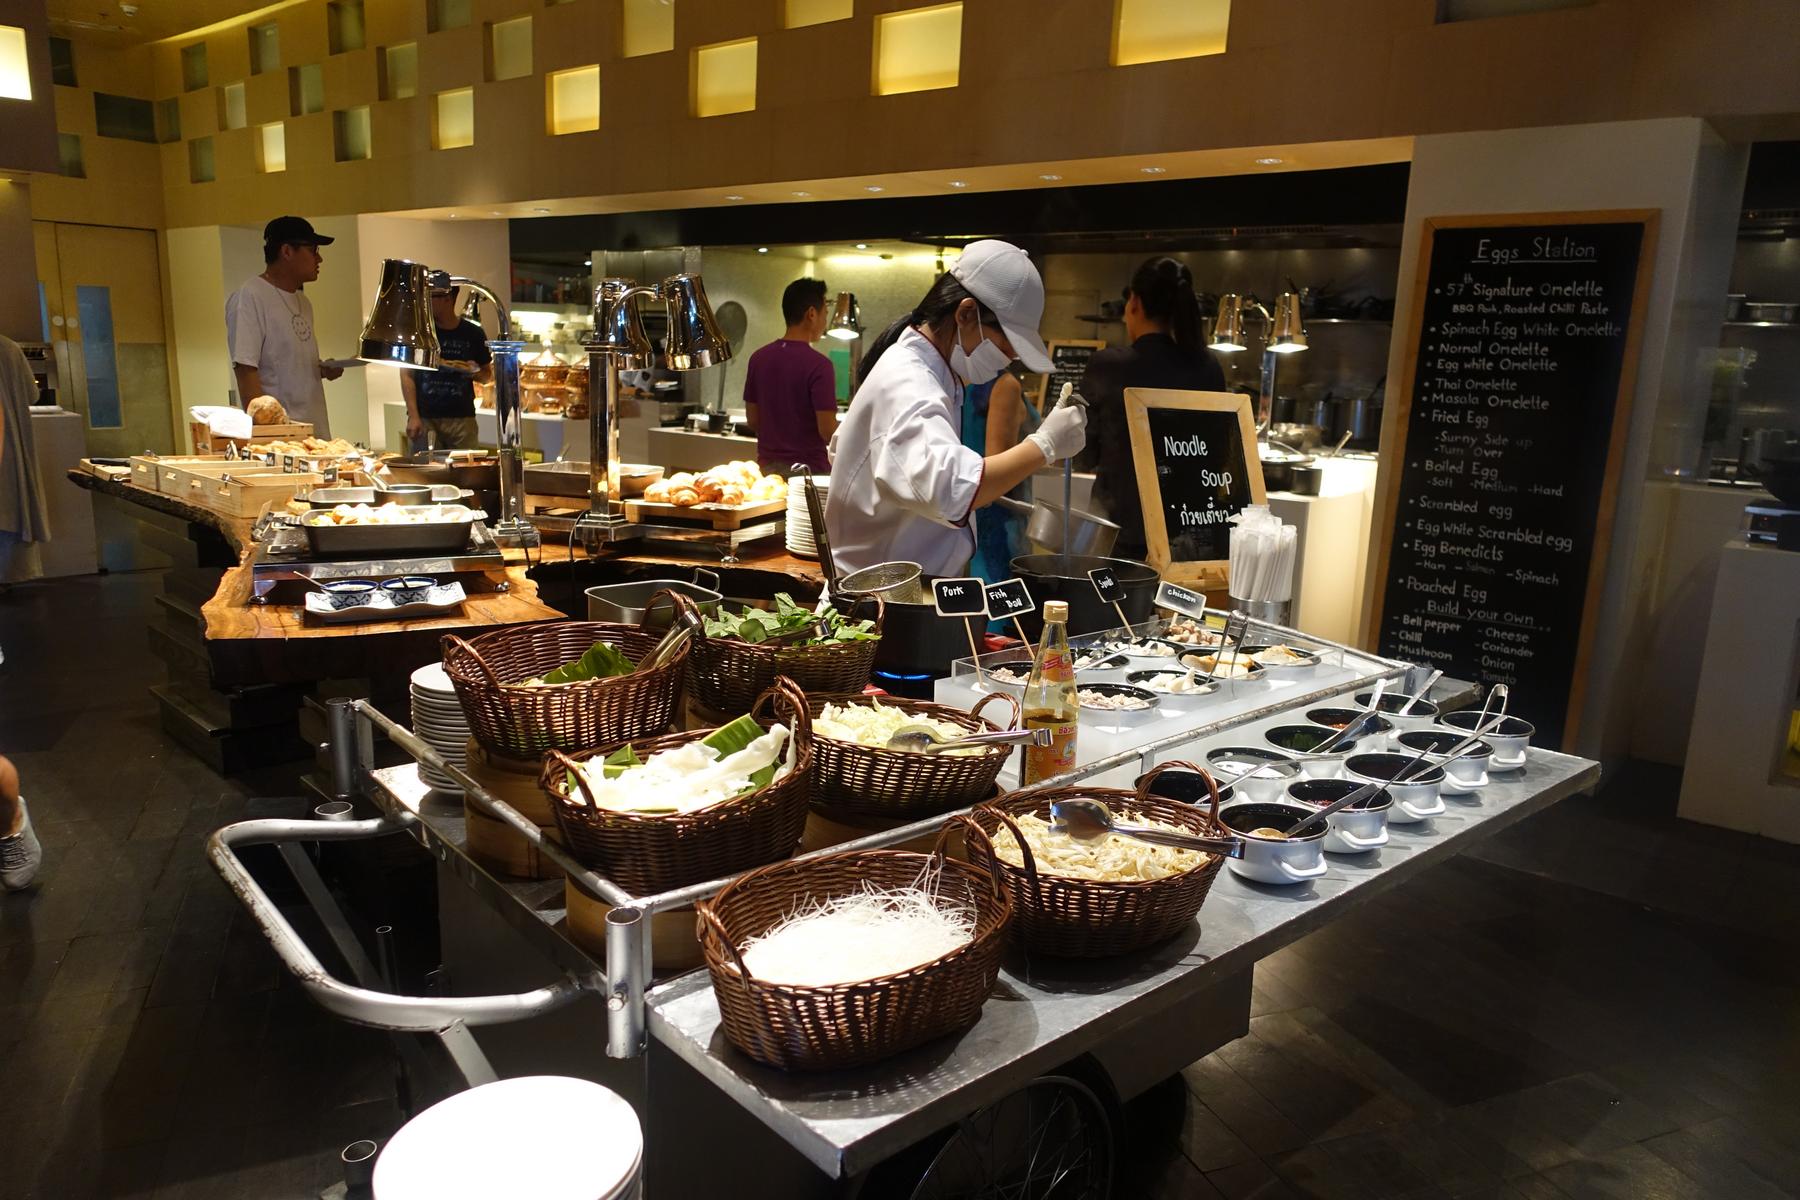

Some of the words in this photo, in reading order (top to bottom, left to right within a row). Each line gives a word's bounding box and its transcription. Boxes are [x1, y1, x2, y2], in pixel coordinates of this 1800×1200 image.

[1477, 239, 1520, 264] Eggs
[1532, 236, 1595, 258] Station
[1473, 277, 1534, 301] Signature
[1540, 280, 1603, 297] Omelette
[1504, 303, 1545, 314] Roasted
[1580, 303, 1609, 315] Paste
[1441, 320, 1489, 340] Spinach
[1494, 323, 1517, 339] Egg
[1523, 323, 1560, 336] White
[1565, 323, 1621, 336] Omelette
[1440, 341, 1482, 354] Normal
[1489, 342, 1549, 356] Omelette
[1437, 359, 1459, 372] Egg
[1464, 359, 1493, 370] white
[1500, 358, 1558, 371] Omelette
[1435, 378, 1461, 390] Thai
[1465, 379, 1517, 390] Omelette
[1432, 394, 1480, 405] Masala
[1488, 396, 1550, 410] Omelette
[1432, 410, 1460, 423] Fried
[1467, 412, 1489, 429] Egg
[1164, 435, 1208, 457] Noodle
[1473, 447, 1503, 458] Over
[1425, 460, 1464, 473] Boiled
[1471, 462, 1498, 480] Egg
[1419, 496, 1478, 513] Scrambled
[1489, 503, 1513, 520] egg
[1417, 519, 1440, 537] Egg
[1443, 523, 1474, 537] White
[1477, 526, 1543, 545] Scrambled
[1546, 536, 1573, 552] egg
[1414, 540, 1436, 558] Egg
[1440, 543, 1504, 562] Benedicts
[942, 586, 964, 598] Pork
[989, 590, 1007, 600] Fish
[1407, 576, 1456, 596] Poached
[1463, 584, 1487, 603] Egg
[1467, 608, 1499, 621] your
[1402, 614, 1423, 627] Bell
[1424, 620, 1462, 633] pepper
[1485, 627, 1530, 643] Cheese
[1482, 641, 1534, 657] Coriander
[1481, 655, 1515, 671] Onion
